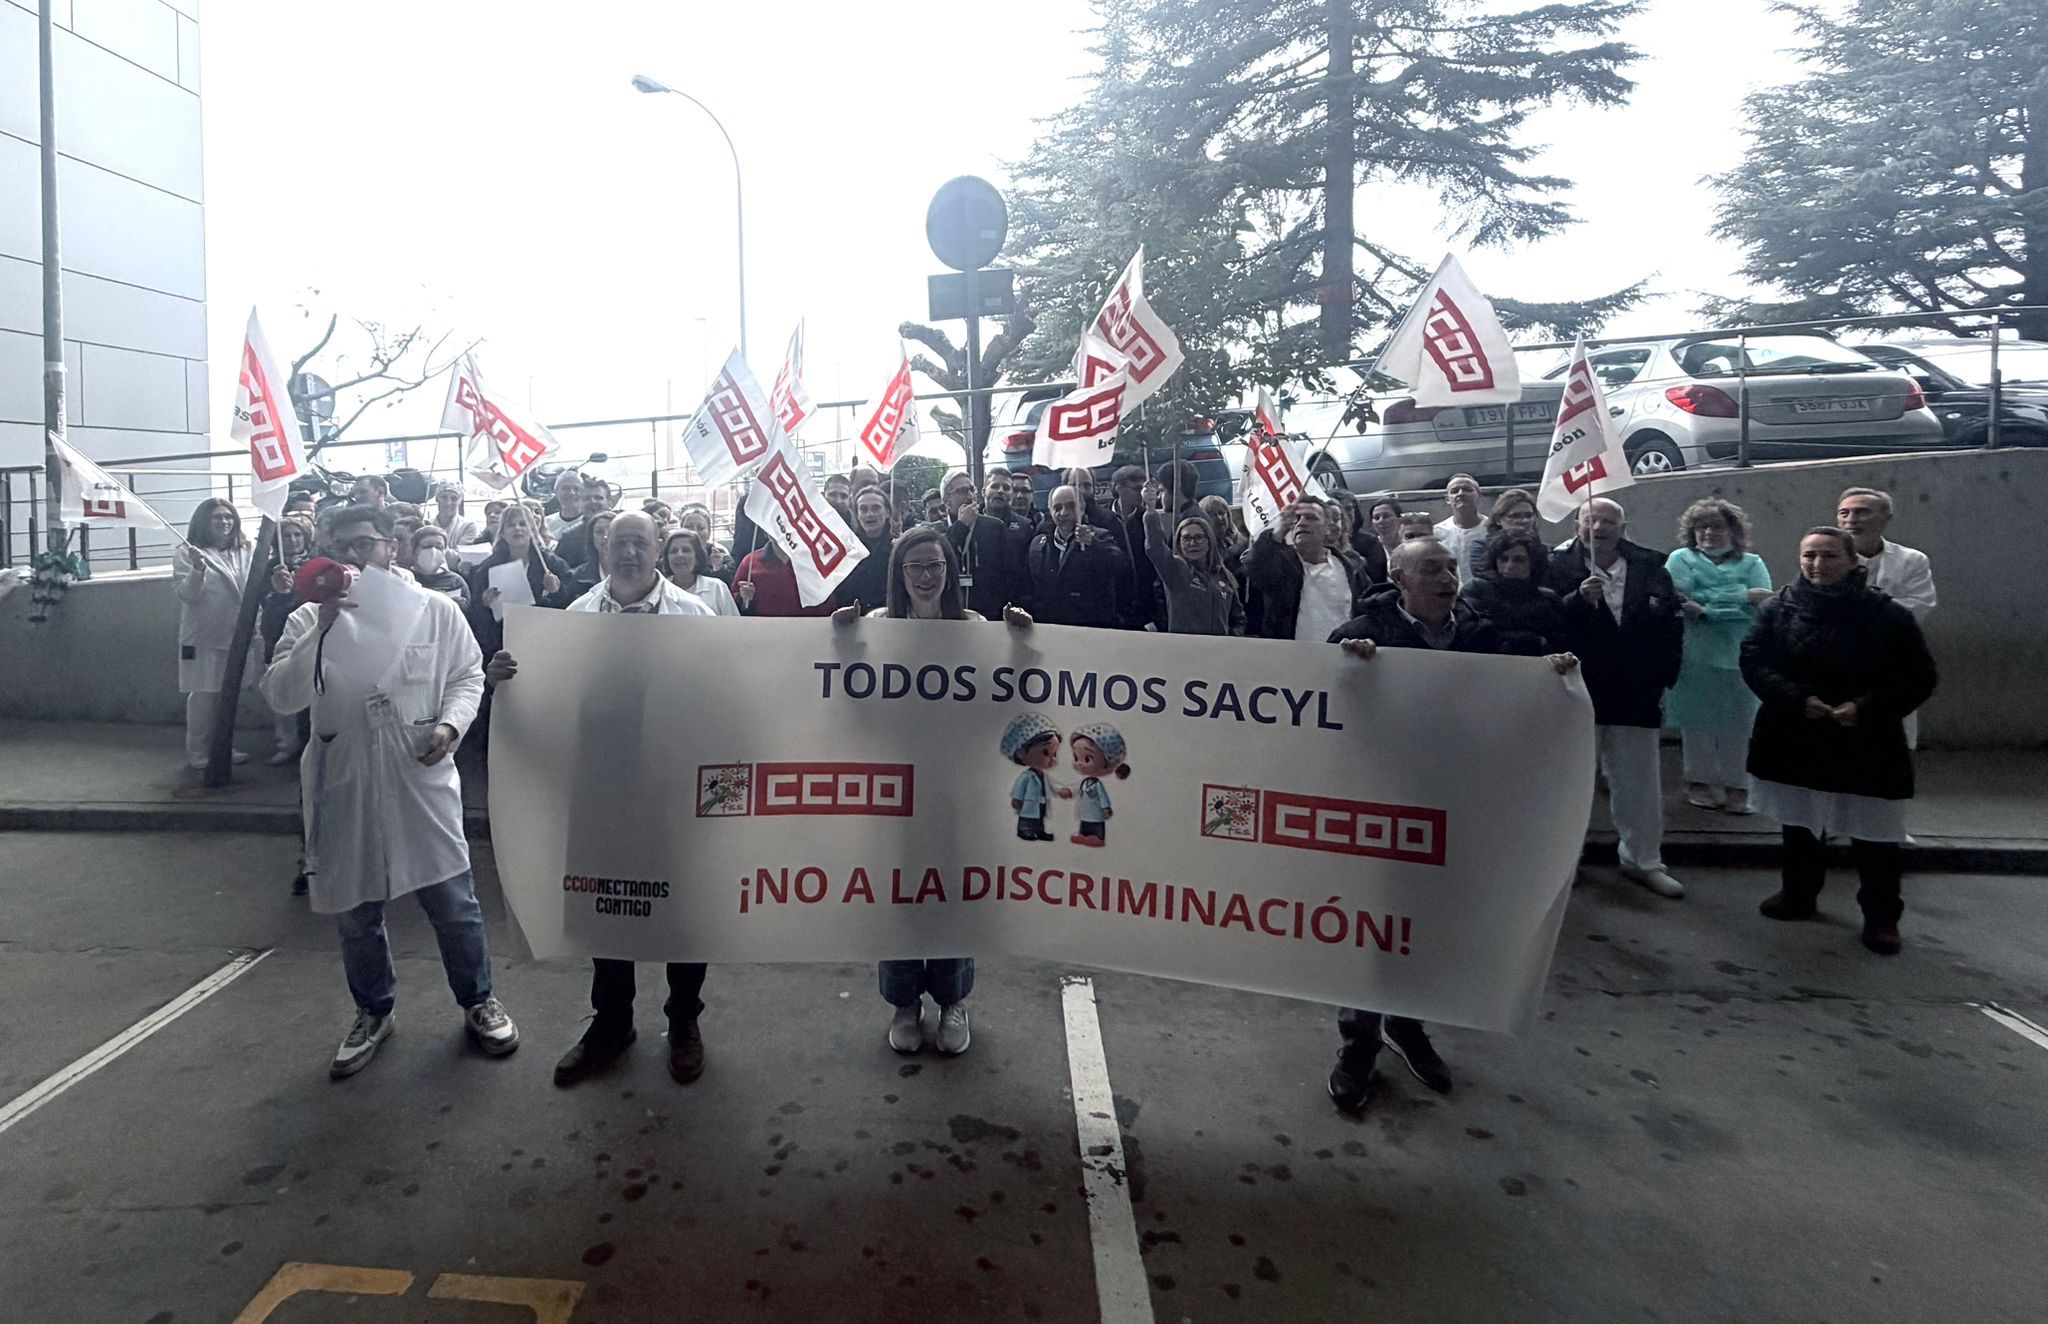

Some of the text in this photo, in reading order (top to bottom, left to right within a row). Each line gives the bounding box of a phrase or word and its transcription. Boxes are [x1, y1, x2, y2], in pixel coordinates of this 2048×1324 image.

[768, 461, 840, 567] CCOO
[814, 662, 1343, 731] TODOS SOMOS SACYL
[764, 772, 905, 808] CCOO
[1274, 803, 1434, 854] CCOO
[739, 865, 1413, 956] ¡NO A LA DISCRIMINACIÓN!
